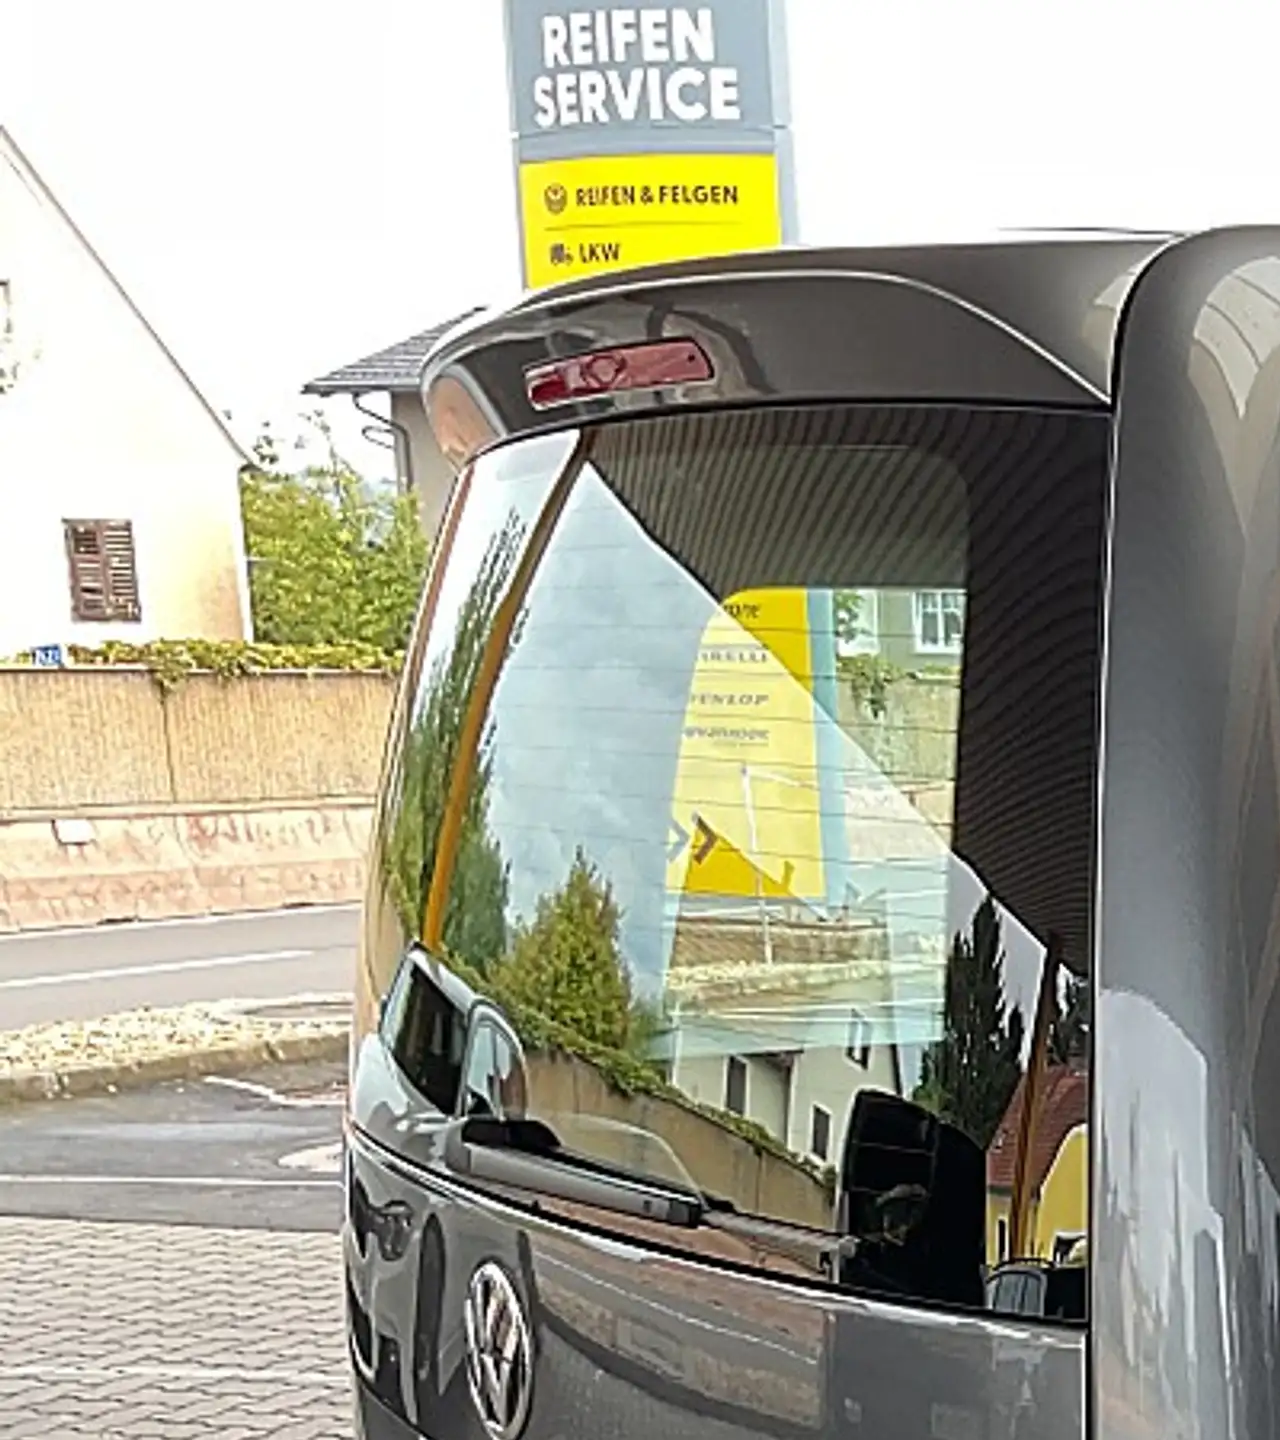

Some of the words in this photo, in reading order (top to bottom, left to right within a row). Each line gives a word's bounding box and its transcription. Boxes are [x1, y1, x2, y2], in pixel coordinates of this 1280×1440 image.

[542, 9, 715, 69] REIFEN
[534, 67, 741, 127] SERVICE
[575, 185, 635, 206] REIFEN
[640, 185, 654, 205] &
[659, 184, 738, 205] FELGEN
[579, 242, 621, 265] LKW
[701, 644, 769, 662] IRELLI
